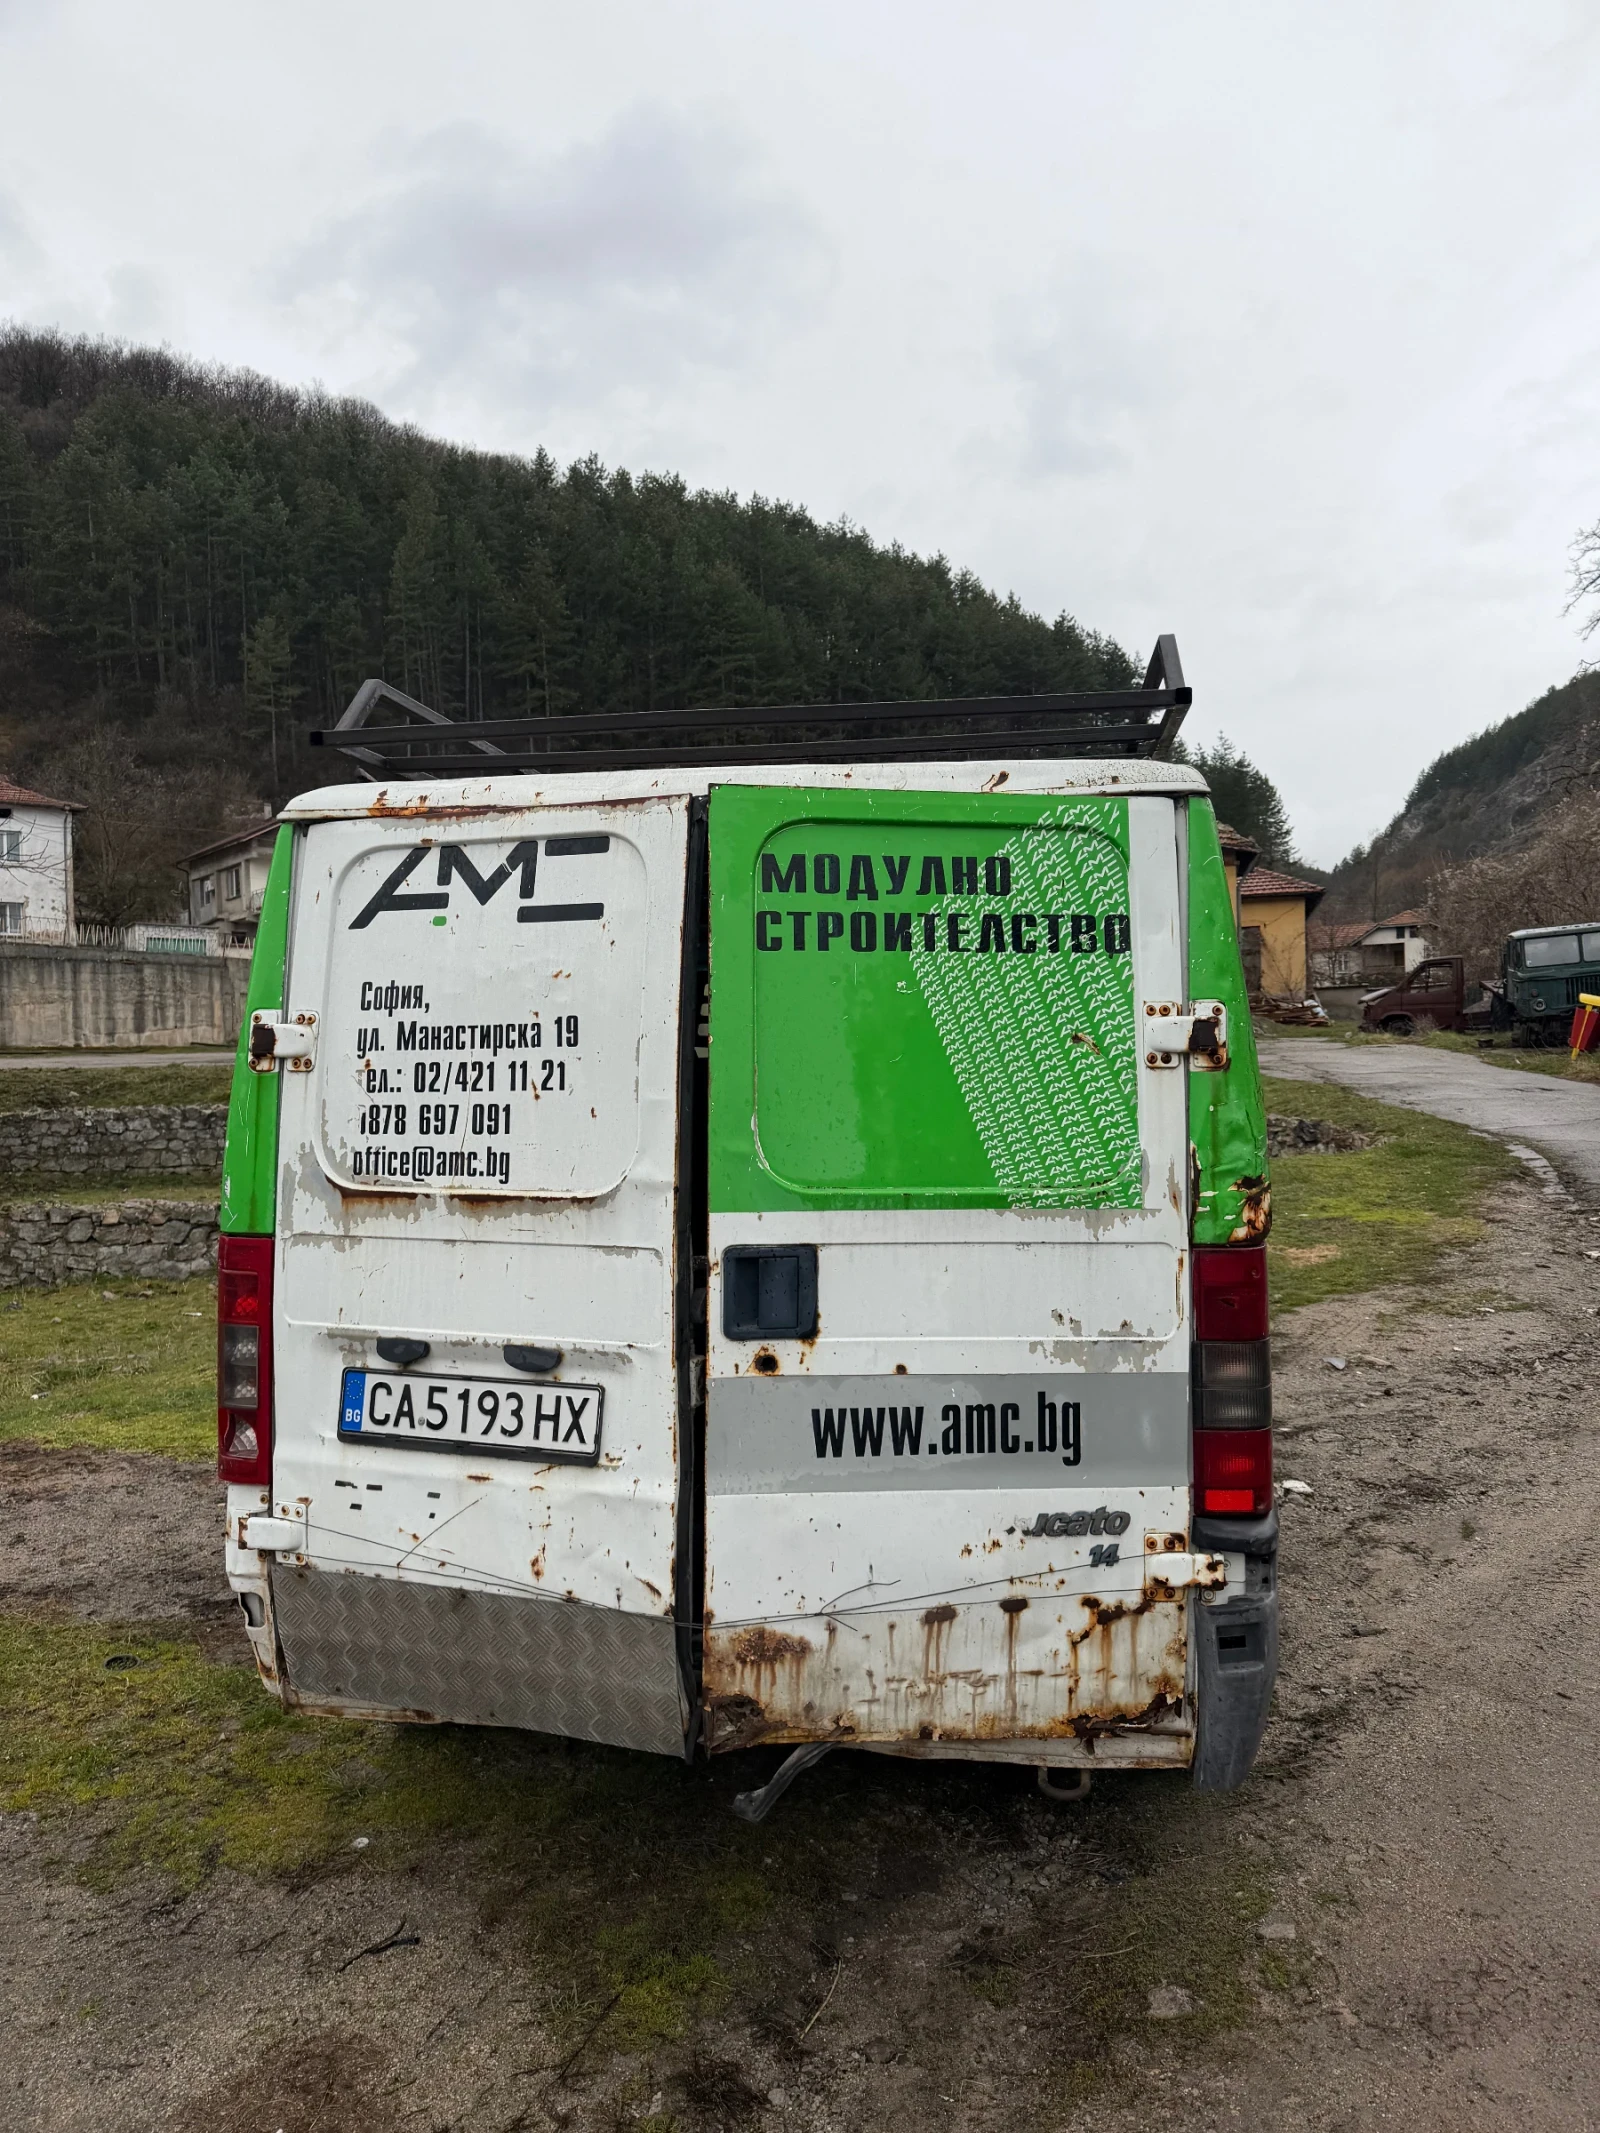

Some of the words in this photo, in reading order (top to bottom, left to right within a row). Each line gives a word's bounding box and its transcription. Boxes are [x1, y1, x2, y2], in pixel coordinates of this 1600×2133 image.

[761, 853, 1011, 900] МОДУЛНО
[756, 911, 1131, 954] СТРОИТЕЛСТВО
[360, 980, 430, 1017] София,
[357, 1027, 385, 1059] ул.
[396, 1021, 541, 1056] Манастирска
[554, 1015, 579, 1047] 19
[357, 1068, 401, 1093] ел.:
[414, 1061, 494, 1095] 02/421
[508, 1060, 528, 1092] 11
[541, 1059, 565, 1091] 21
[419, 1104, 459, 1135] 697
[472, 1103, 511, 1135] 091
[353, 1146, 510, 1185] office@amc.bg
[345, 1407, 361, 1423] BG
[811, 1391, 1082, 1466] www.amc.bg
[1088, 1543, 1120, 1568] 14
